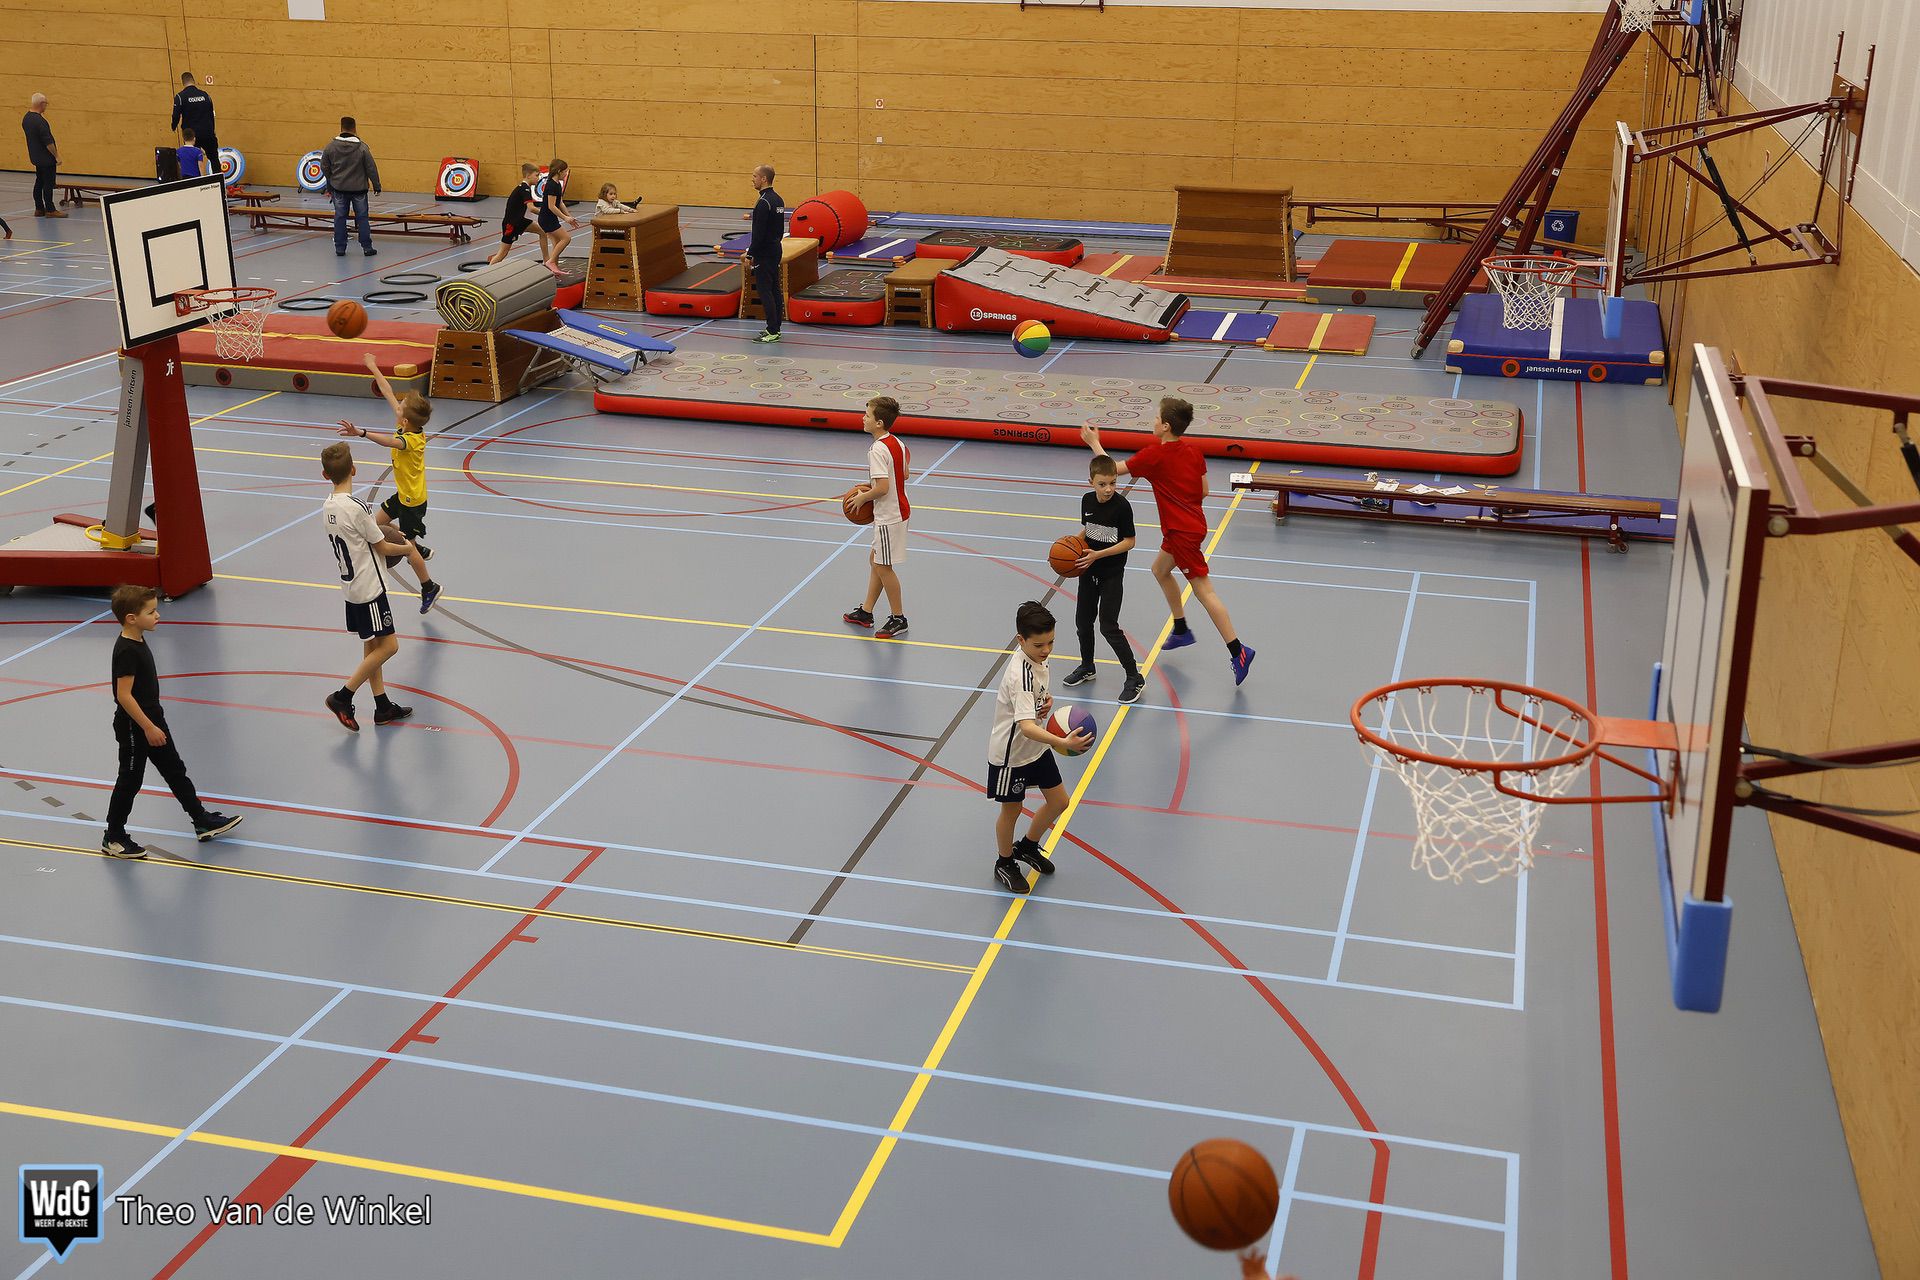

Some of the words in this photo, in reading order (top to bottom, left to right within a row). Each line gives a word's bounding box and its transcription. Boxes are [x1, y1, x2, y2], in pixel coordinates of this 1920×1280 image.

[983, 312, 1017, 321] SPRINGS
[1525, 366, 1582, 375] janssen-fritsen
[993, 428, 1034, 438] SPRINGS
